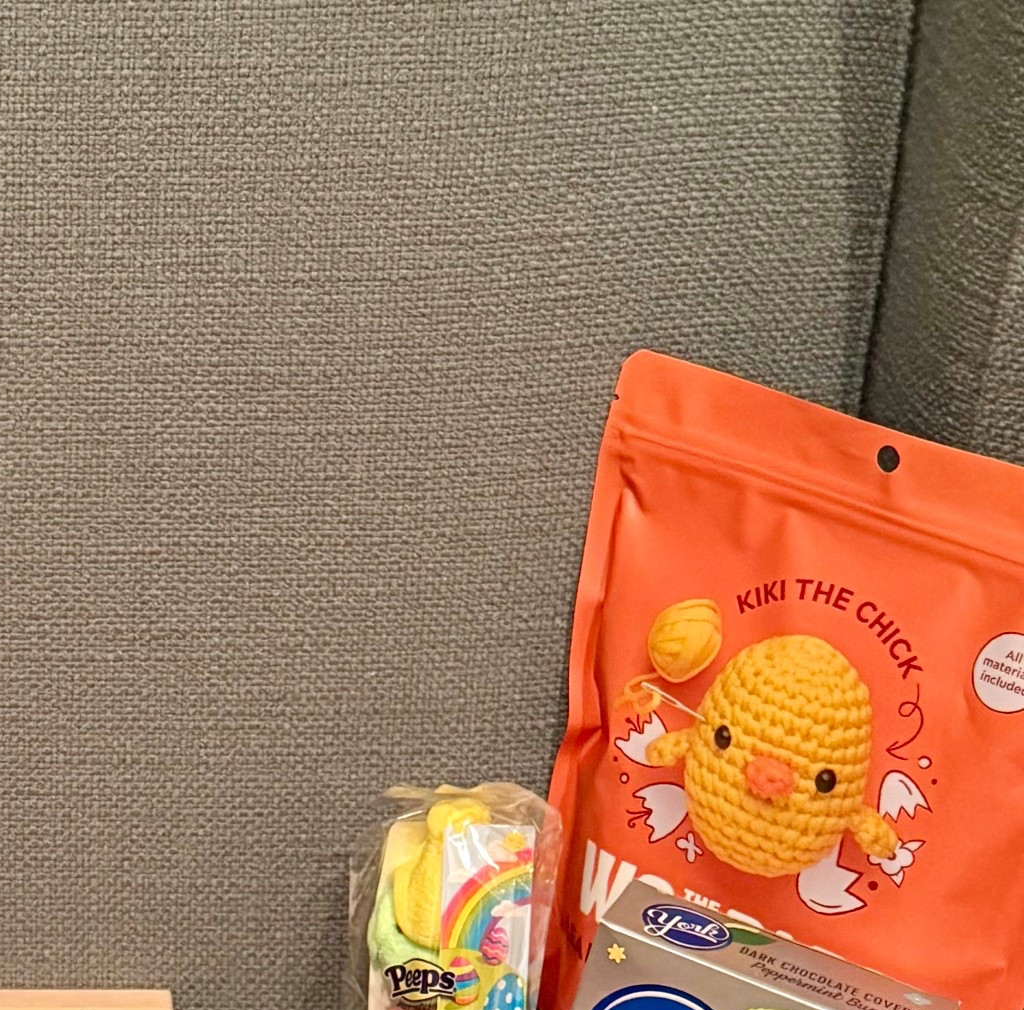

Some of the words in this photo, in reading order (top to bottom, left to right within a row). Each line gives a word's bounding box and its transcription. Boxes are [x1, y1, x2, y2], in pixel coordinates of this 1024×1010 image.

[736, 579, 786, 614] KIKI
[795, 578, 855, 611] THE
[856, 601, 923, 680] CHICK
[1005, 650, 1023, 664] All
[643, 909, 719, 943] York
[384, 965, 456, 994] Peeps
[739, 946, 775, 966] DARK
[781, 961, 857, 996] CHOCOLATE
[750, 961, 844, 1001] Peppermint
